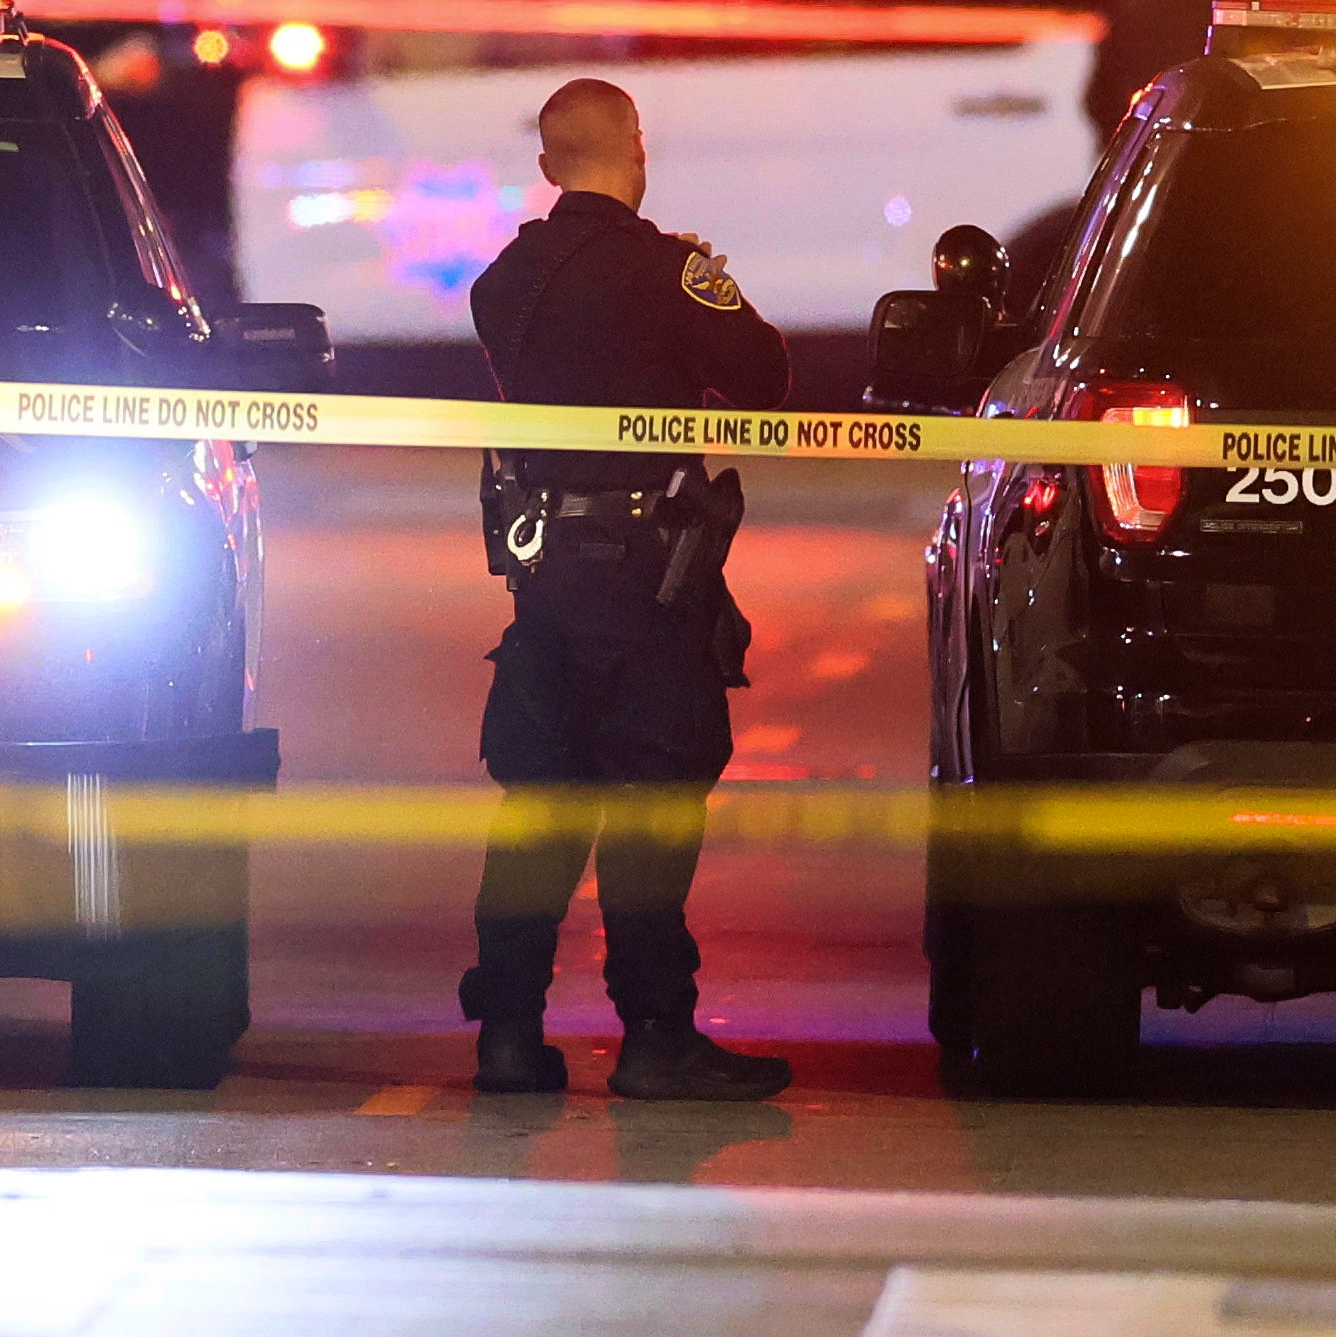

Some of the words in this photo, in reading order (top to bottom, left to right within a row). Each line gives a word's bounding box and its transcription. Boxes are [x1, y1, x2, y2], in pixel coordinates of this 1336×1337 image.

[18, 392, 95, 423] POLICE
[103, 395, 150, 425] LINE
[158, 397, 187, 426] DO
[195, 399, 240, 429] NOT
[246, 400, 319, 432] CROSS
[618, 414, 696, 443] POLICE
[703, 416, 752, 446] LINE
[759, 418, 789, 448] DO
[797, 420, 843, 449] NOT
[848, 421, 921, 451] CROSS
[1222, 432, 1302, 462] POLICE
